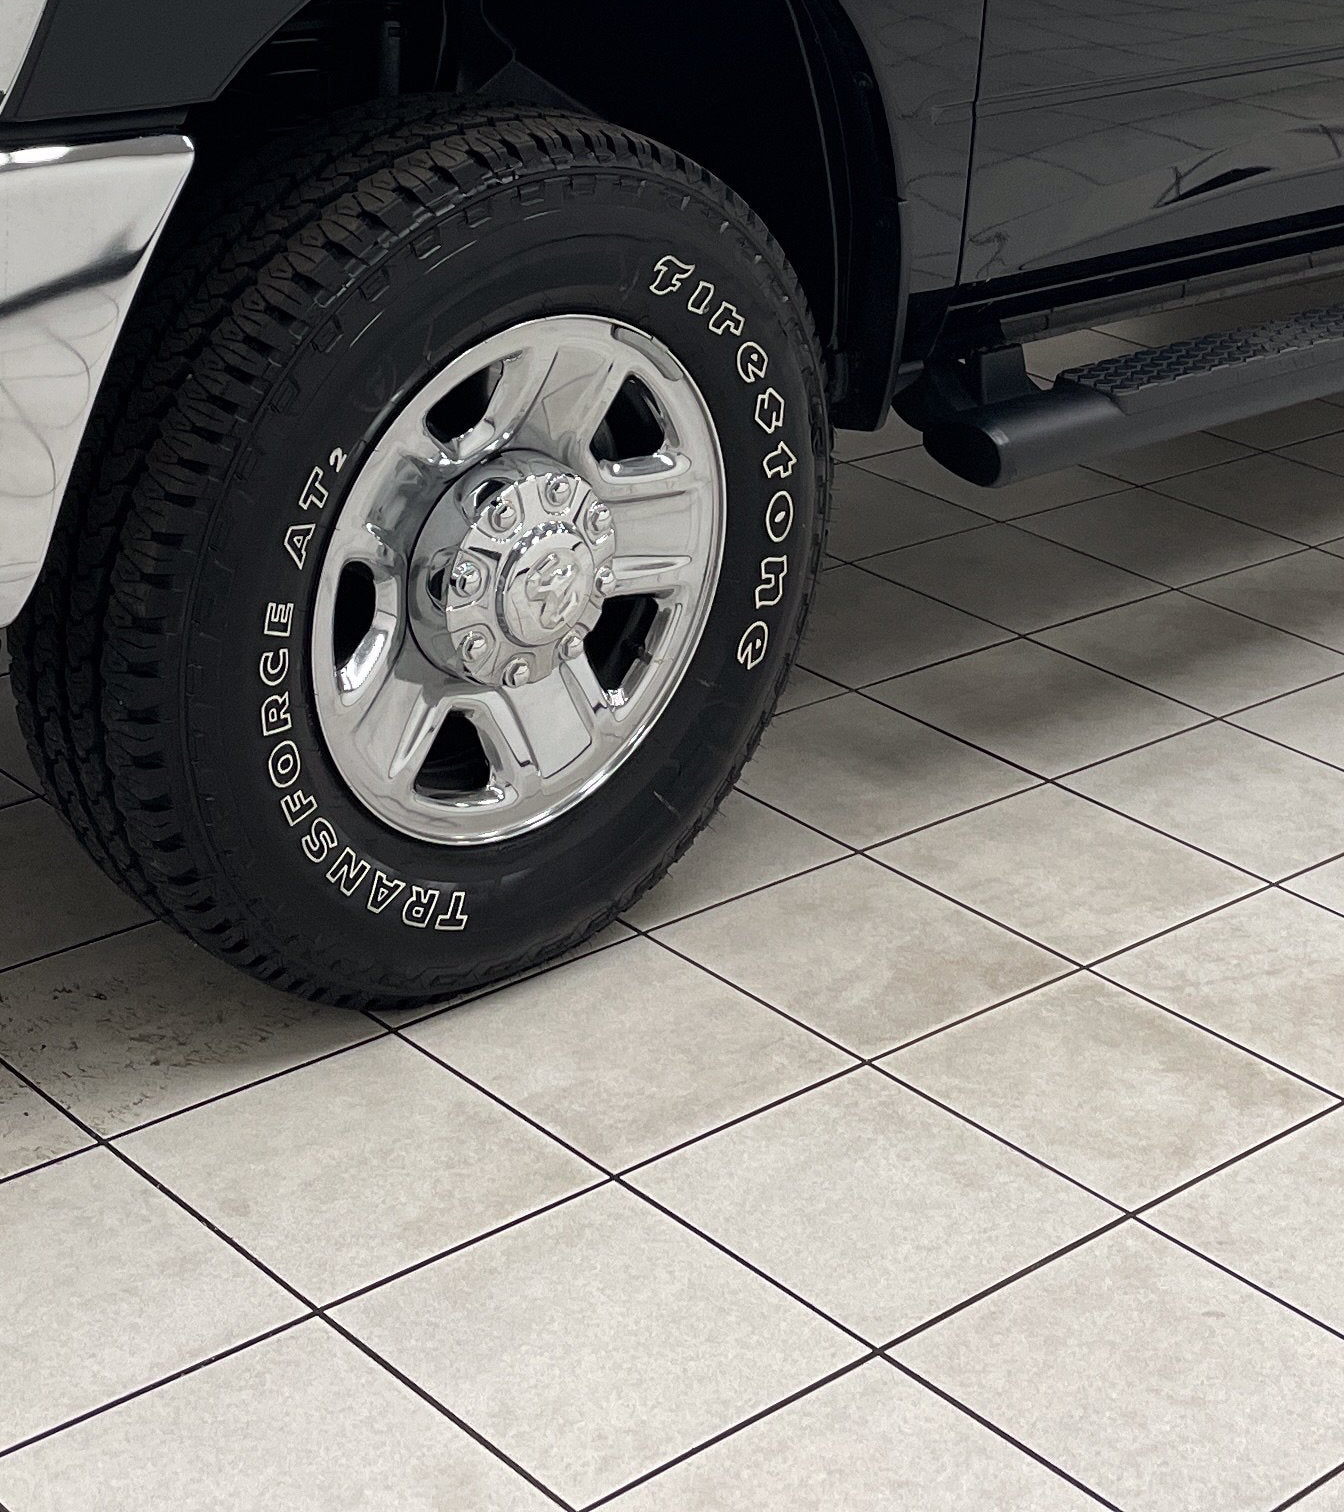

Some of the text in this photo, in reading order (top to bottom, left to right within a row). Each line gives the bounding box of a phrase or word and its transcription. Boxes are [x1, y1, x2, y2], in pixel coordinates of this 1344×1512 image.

[649, 254, 795, 670] Firestone
[260, 446, 470, 932] TRANSFORCE AT2
